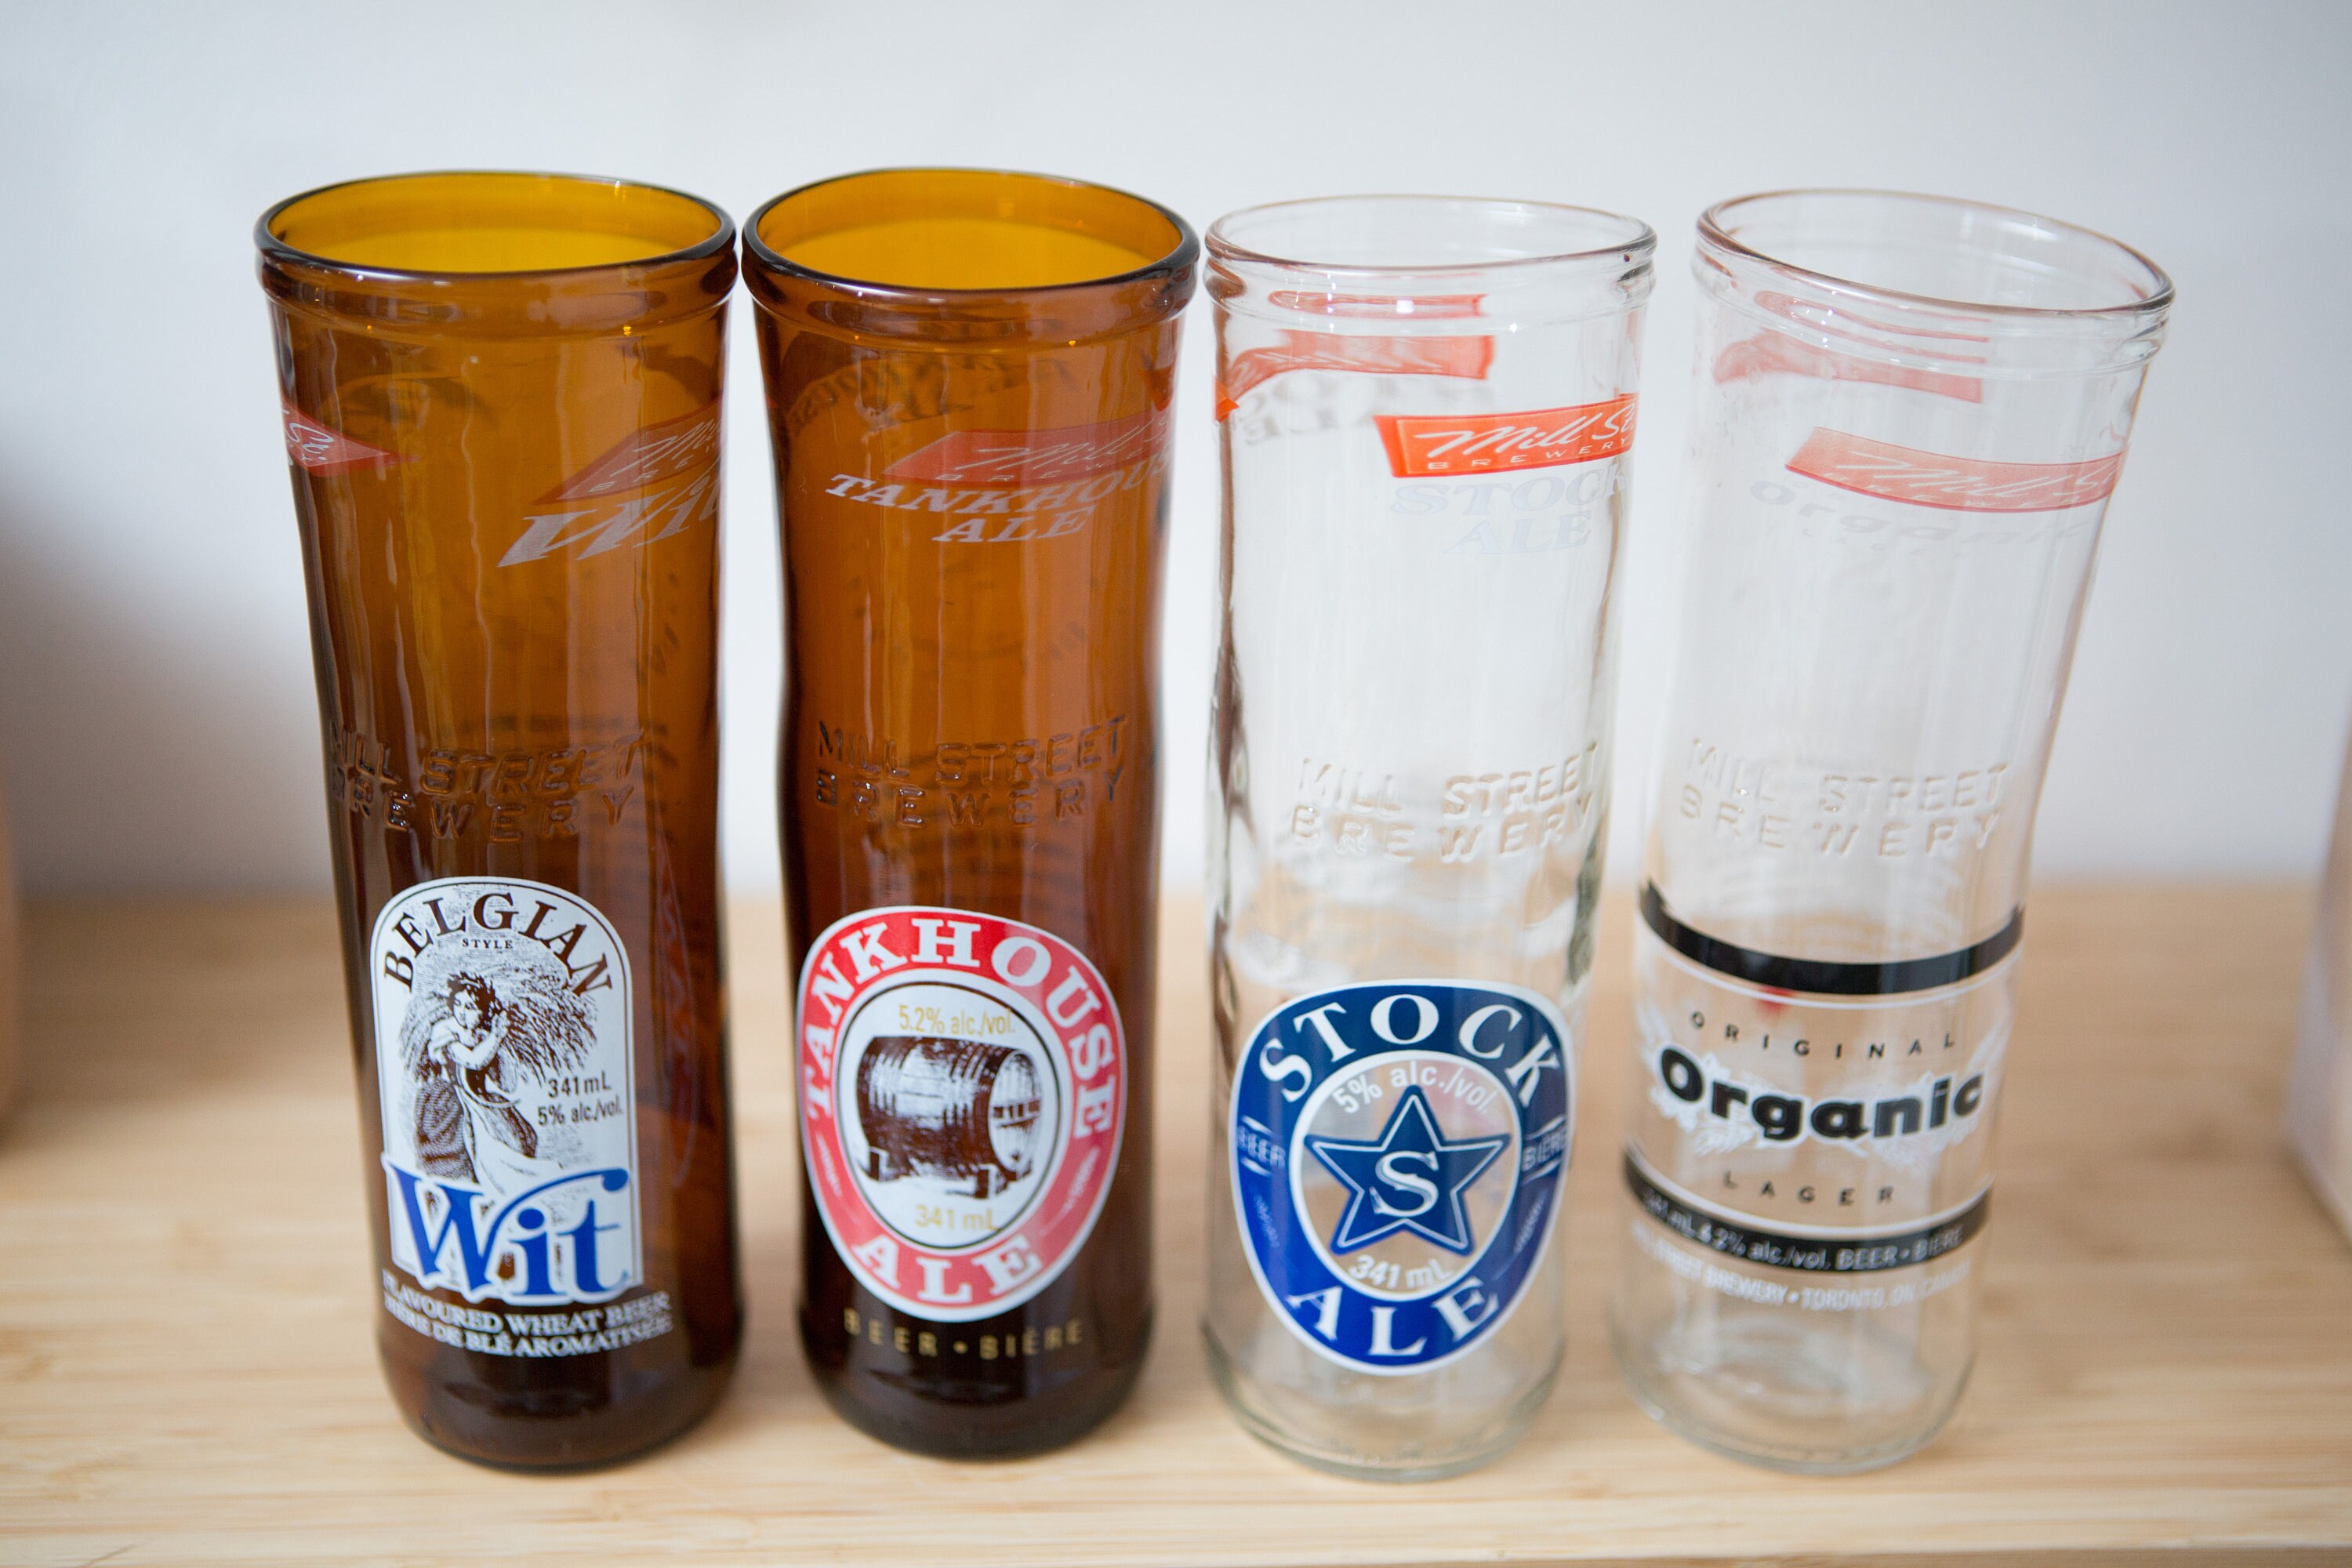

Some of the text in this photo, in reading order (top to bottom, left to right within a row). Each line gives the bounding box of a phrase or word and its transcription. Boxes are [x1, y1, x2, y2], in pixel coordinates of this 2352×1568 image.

[1414, 412, 1603, 458] Mill
[1428, 437, 1628, 470] BREWERY
[1835, 450, 2074, 499] Mill
[932, 506, 1097, 543] ALE
[1444, 510, 1592, 555] ALE
[935, 714, 1125, 785] STREET
[816, 765, 1124, 829] BREWERY
[1442, 741, 1599, 819] STREET
[1818, 761, 2009, 814] STREET
[1292, 791, 1593, 863] BREWERY
[1680, 782, 2002, 857] BREWERY
[383, 891, 612, 997] BELGIAN
[461, 938, 514, 950] STYLE
[804, 918, 1118, 1139] TANKHOUSE
[898, 1004, 1016, 1037] 5.2% alc./vol.
[1690, 1011, 1955, 1059] ORIGINAL
[1259, 993, 1562, 1108] STOCK
[1332, 1058, 1501, 1115] 5% alc./vol.
[1659, 1046, 1985, 1142] Organic
[537, 1103, 565, 1127] 5%
[1237, 1124, 1287, 1169] BEER
[1369, 1150, 1440, 1218] S
[1723, 1171, 1895, 1205] LAGER
[387, 1167, 630, 1297] Wit
[914, 1205, 1000, 1232] 341 mL
[853, 1235, 1045, 1304] ALE
[1348, 1254, 1456, 1290] 341 mL
[1836, 1245, 1898, 1271] BEER
[1704, 1263, 1790, 1306] BREWERY
[432, 1321, 464, 1348] DE
[504, 1308, 603, 1338] WHEAT
[604, 1290, 673, 1330] BEER
[844, 1307, 938, 1357] BEER
[1286, 1275, 1501, 1356] ALE
